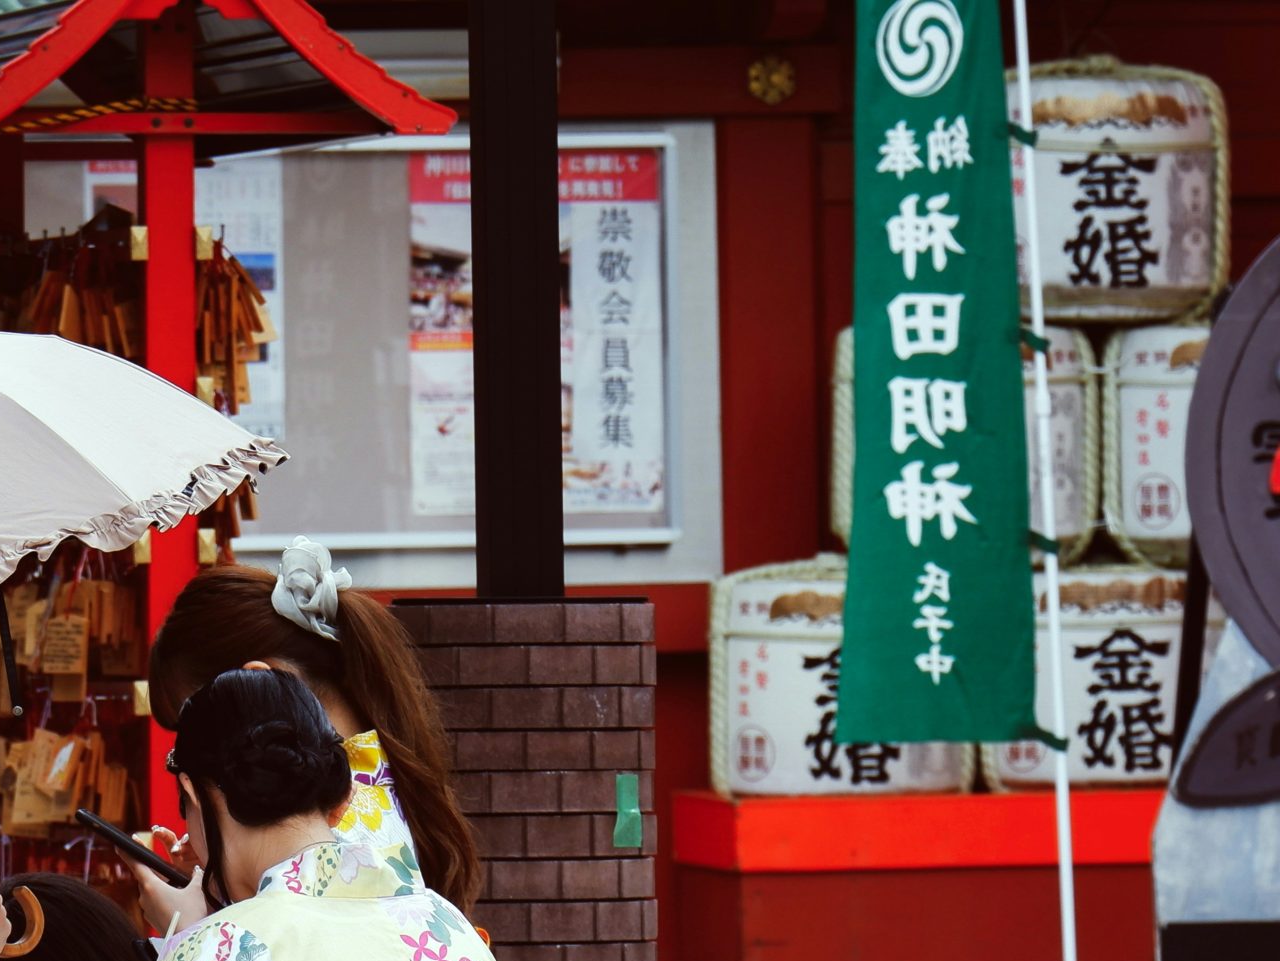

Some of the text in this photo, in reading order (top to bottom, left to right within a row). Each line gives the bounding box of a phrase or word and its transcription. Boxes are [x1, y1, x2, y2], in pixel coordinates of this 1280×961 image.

[1059, 136, 1160, 288] 金婚
[597, 206, 635, 449] 崇敬会員募集
[1073, 626, 1173, 773] 金婚
